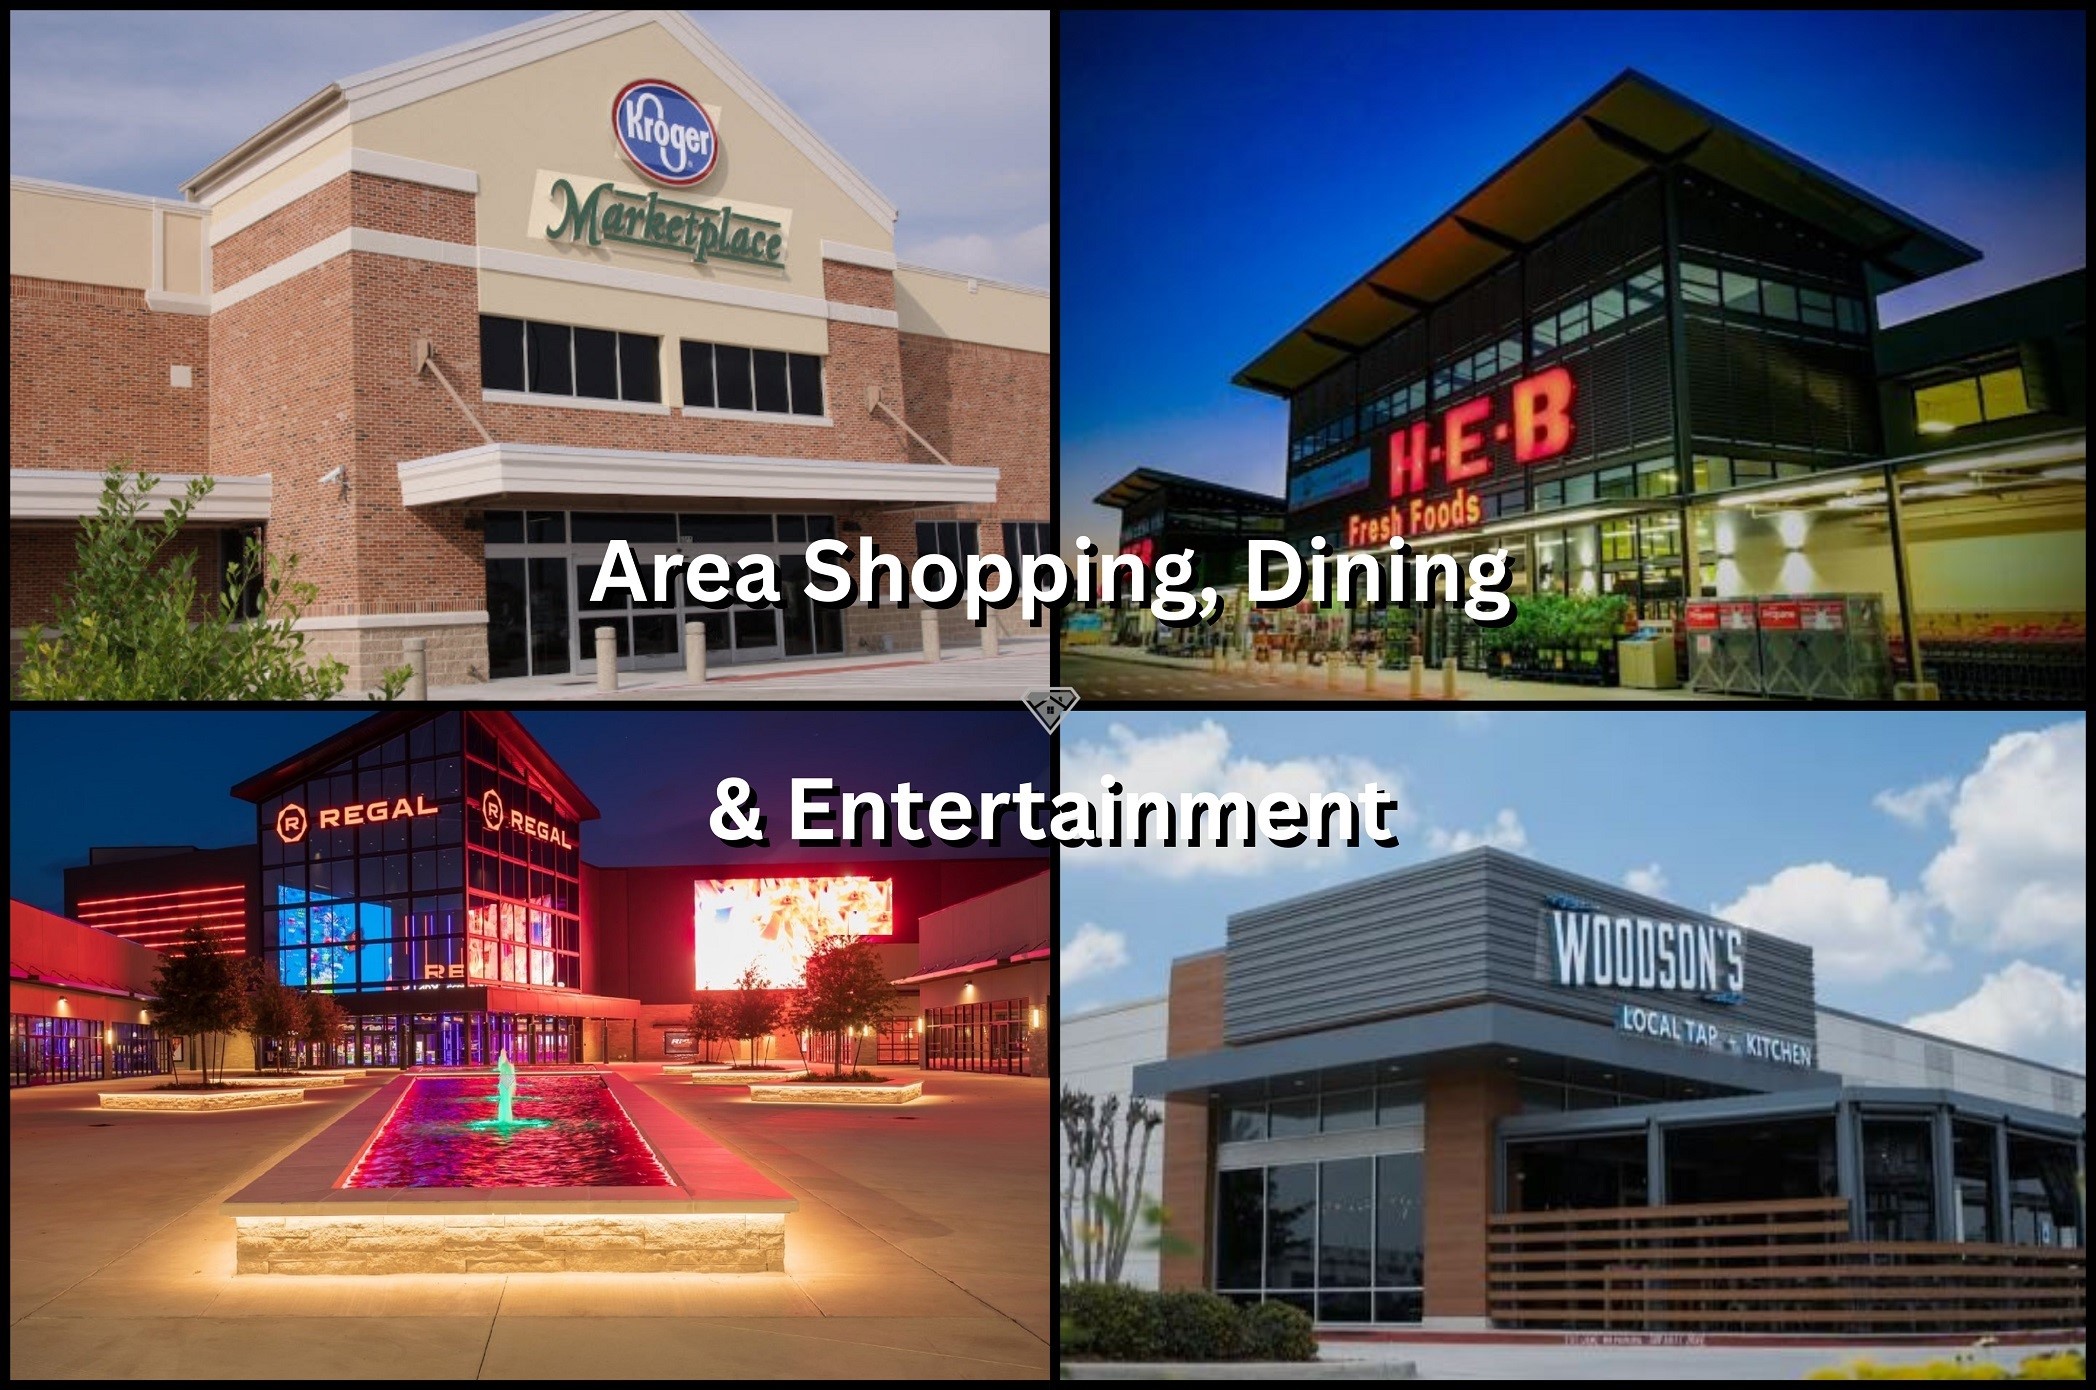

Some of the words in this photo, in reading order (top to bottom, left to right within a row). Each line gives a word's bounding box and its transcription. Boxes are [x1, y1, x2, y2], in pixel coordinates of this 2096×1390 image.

[626, 92, 711, 173] Kroger
[546, 178, 785, 265] Marketplace
[1349, 504, 1403, 547] Fresh
[1410, 487, 1481, 535] Foods
[319, 795, 439, 830] REGAL
[510, 808, 572, 850] REGAL
[1553, 911, 1744, 992] WOODSON'S
[1622, 1004, 1681, 1040] LOCAL
[1685, 1019, 1719, 1045] TAP
[1745, 1033, 1812, 1067] KITCHEN
